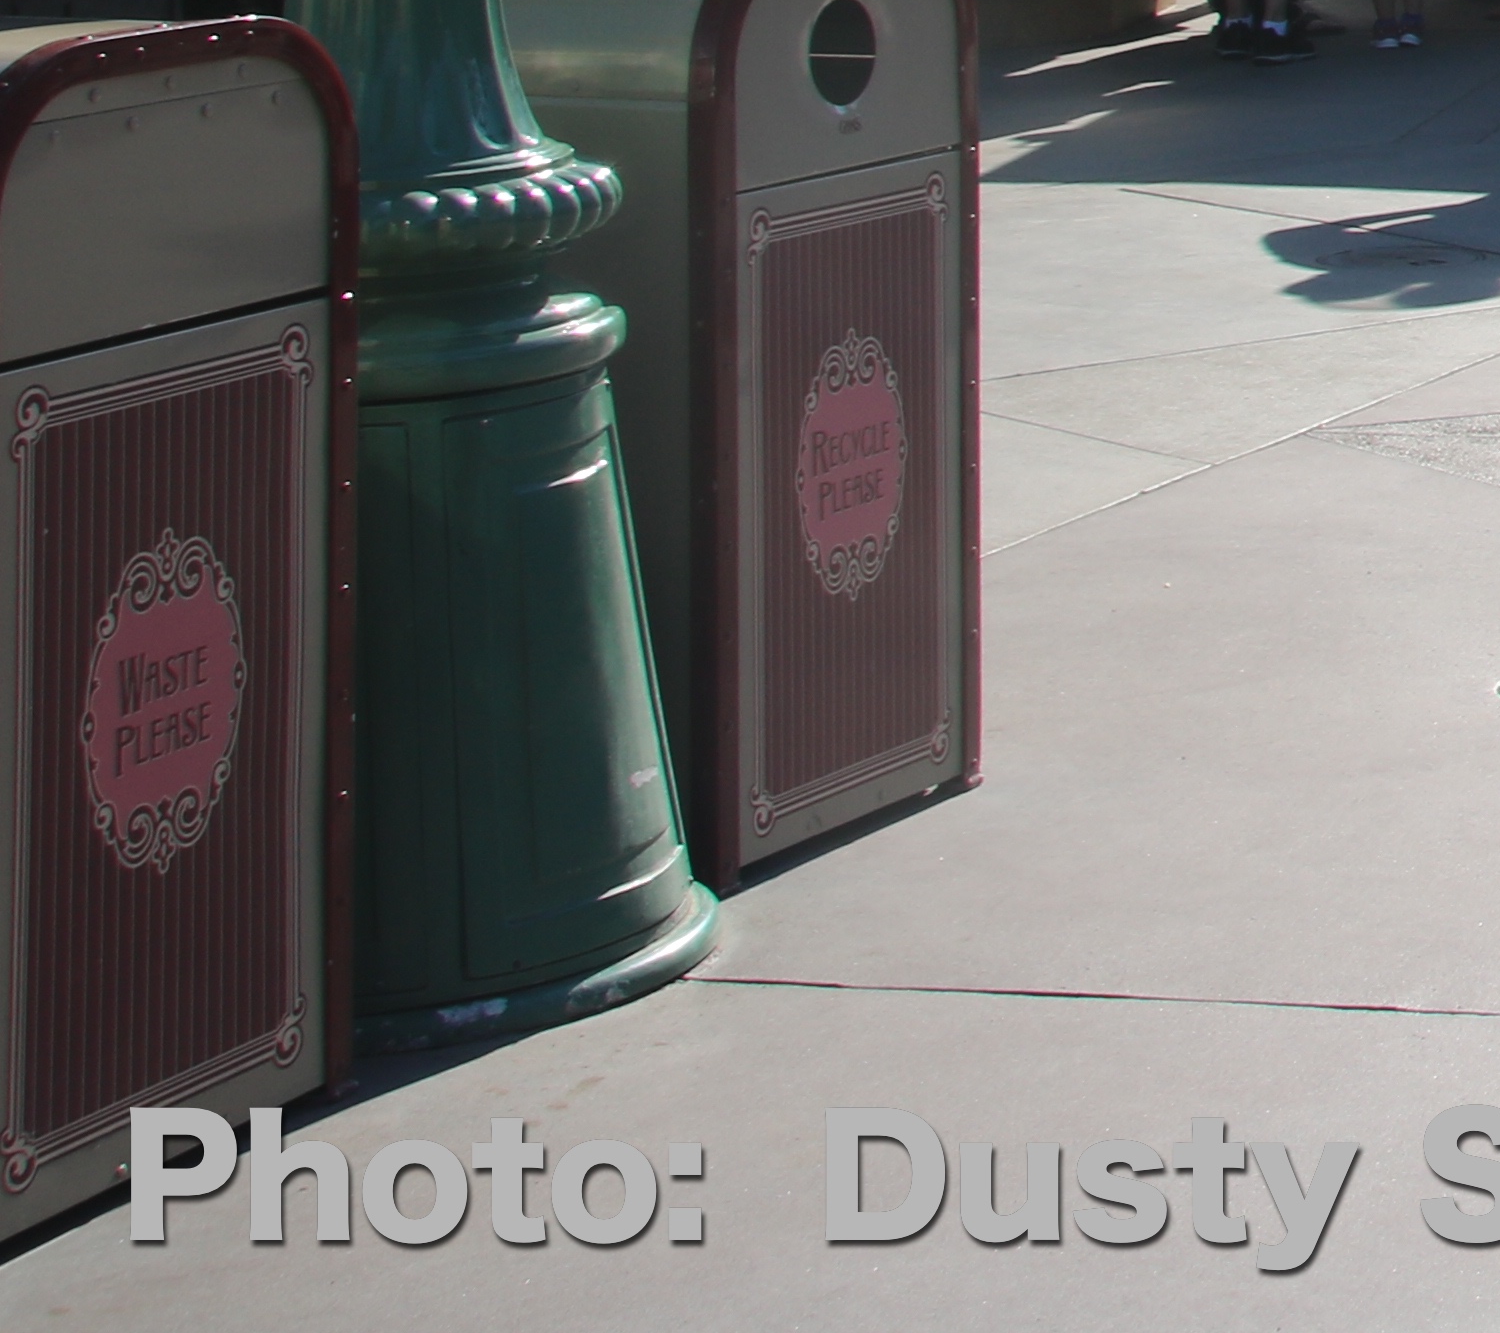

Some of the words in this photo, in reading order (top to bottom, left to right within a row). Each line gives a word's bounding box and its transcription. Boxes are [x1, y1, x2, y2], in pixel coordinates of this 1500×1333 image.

[812, 421, 890, 476] RECYCLE
[819, 469, 884, 521] PLEASE
[118, 645, 208, 717] WASTE
[114, 701, 212, 777] PLEASE
